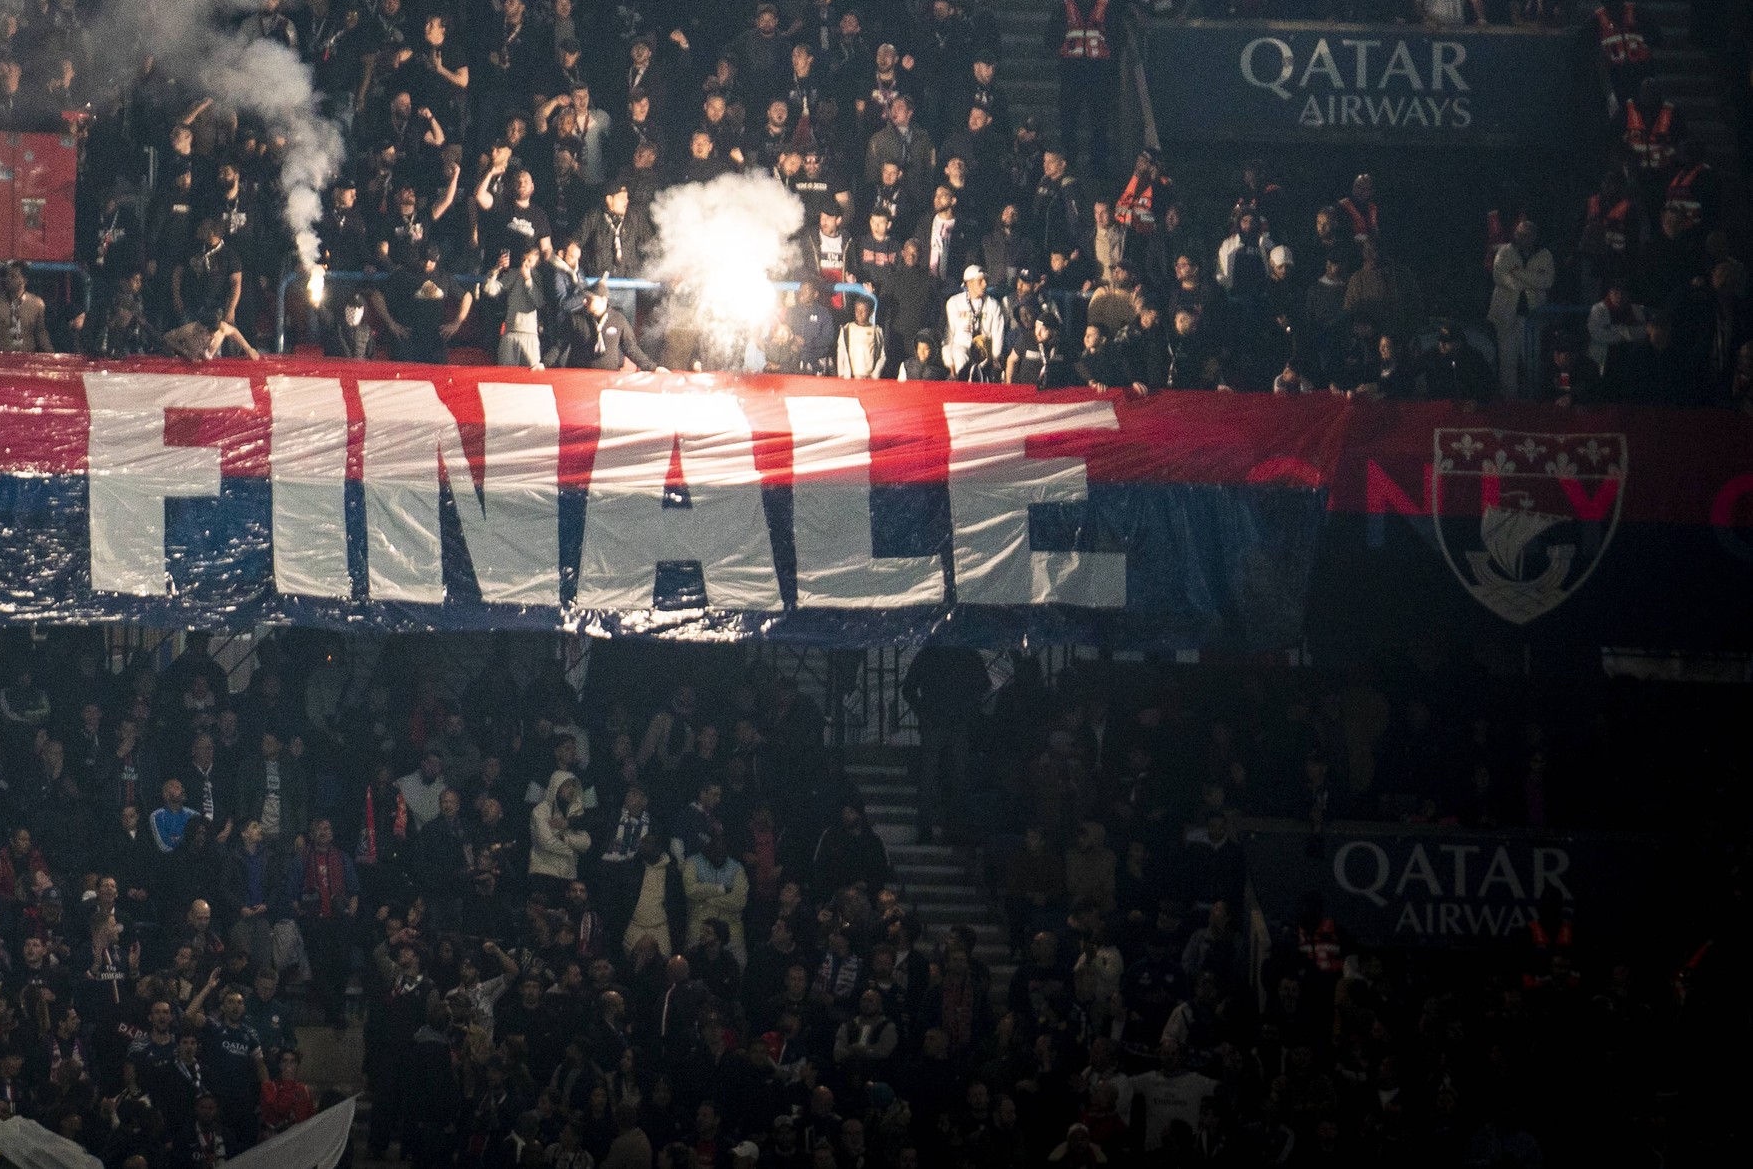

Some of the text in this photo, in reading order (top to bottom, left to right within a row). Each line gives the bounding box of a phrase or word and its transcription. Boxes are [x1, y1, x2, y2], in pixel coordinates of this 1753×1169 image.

[1240, 37, 1471, 100] QATAR
[1298, 94, 1472, 129] AIRWAYS
[82, 372, 1128, 609] FINALE
[1333, 840, 1575, 908] QATAR
